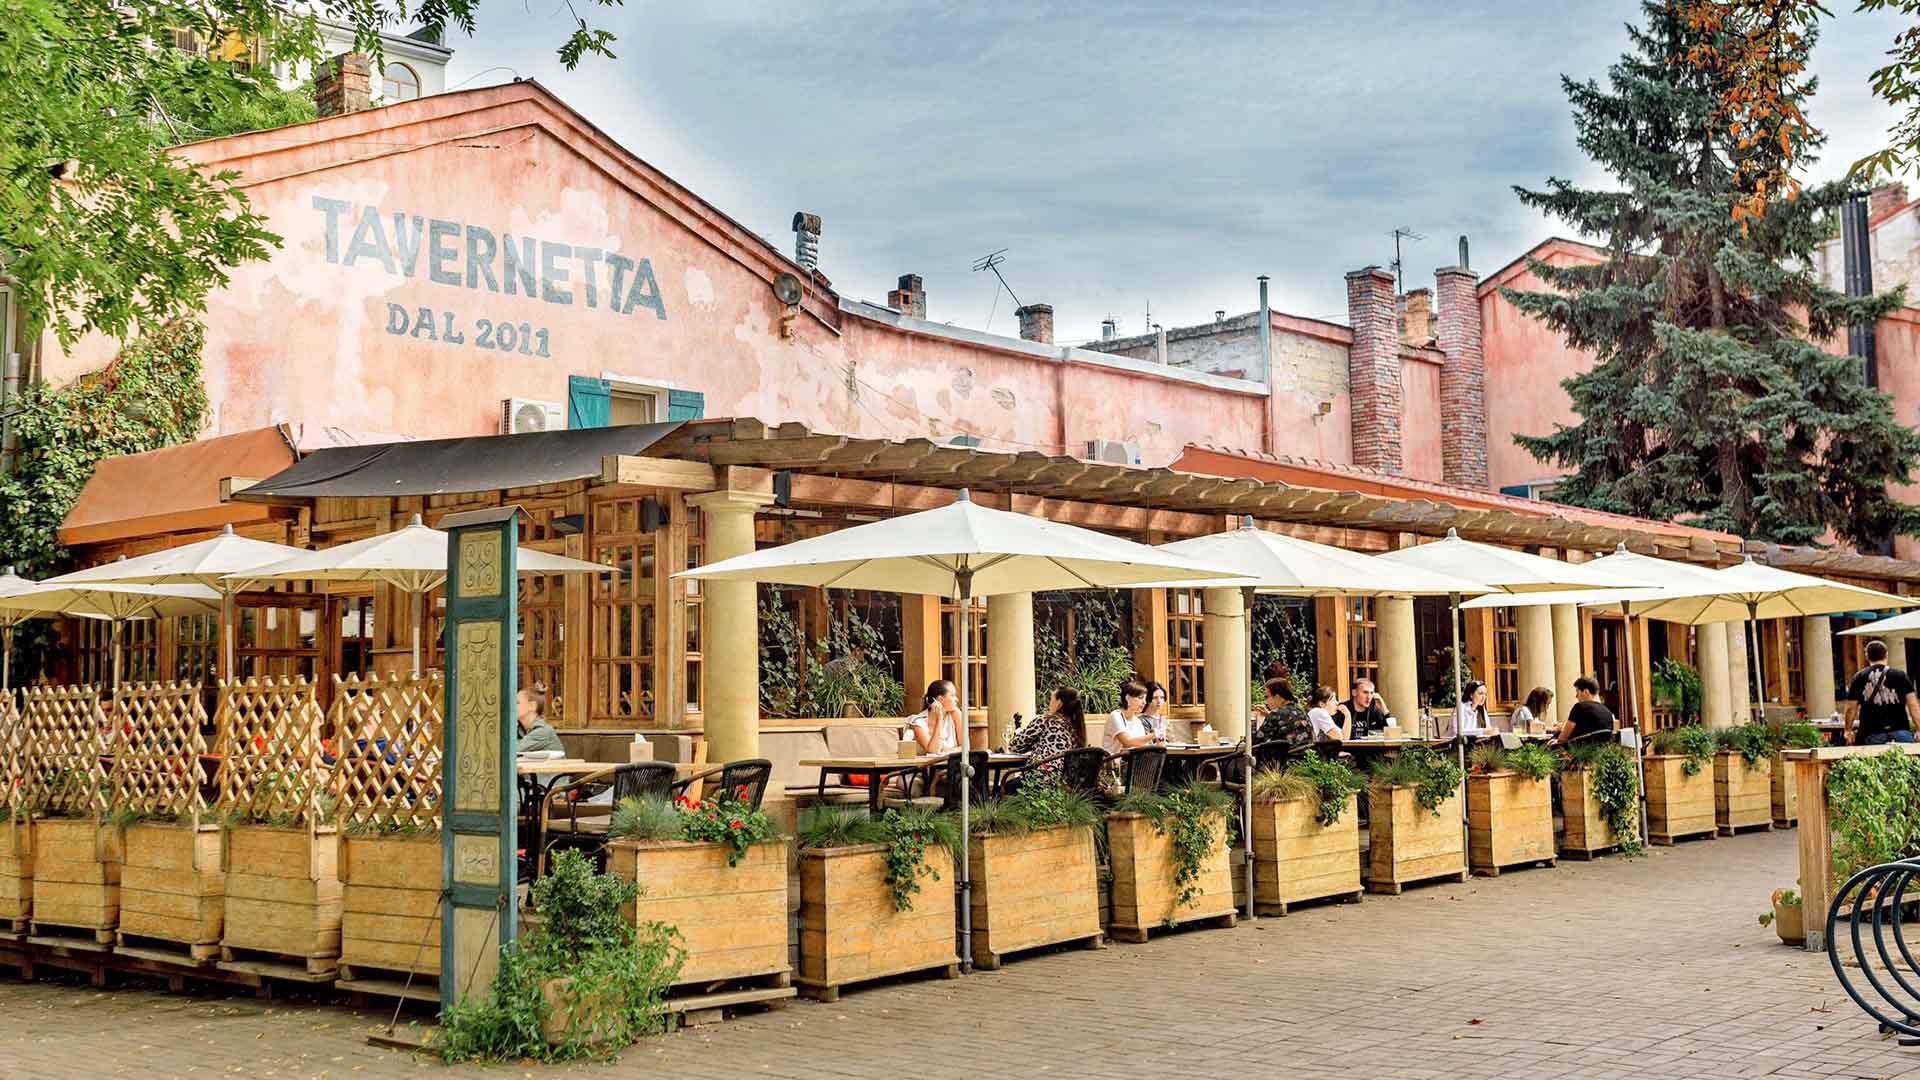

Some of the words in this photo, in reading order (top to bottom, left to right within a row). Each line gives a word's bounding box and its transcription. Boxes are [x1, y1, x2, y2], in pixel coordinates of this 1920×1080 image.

[313, 195, 667, 320] TAVERNETTA
[386, 303, 464, 345] DAL
[475, 319, 551, 358] 2011
